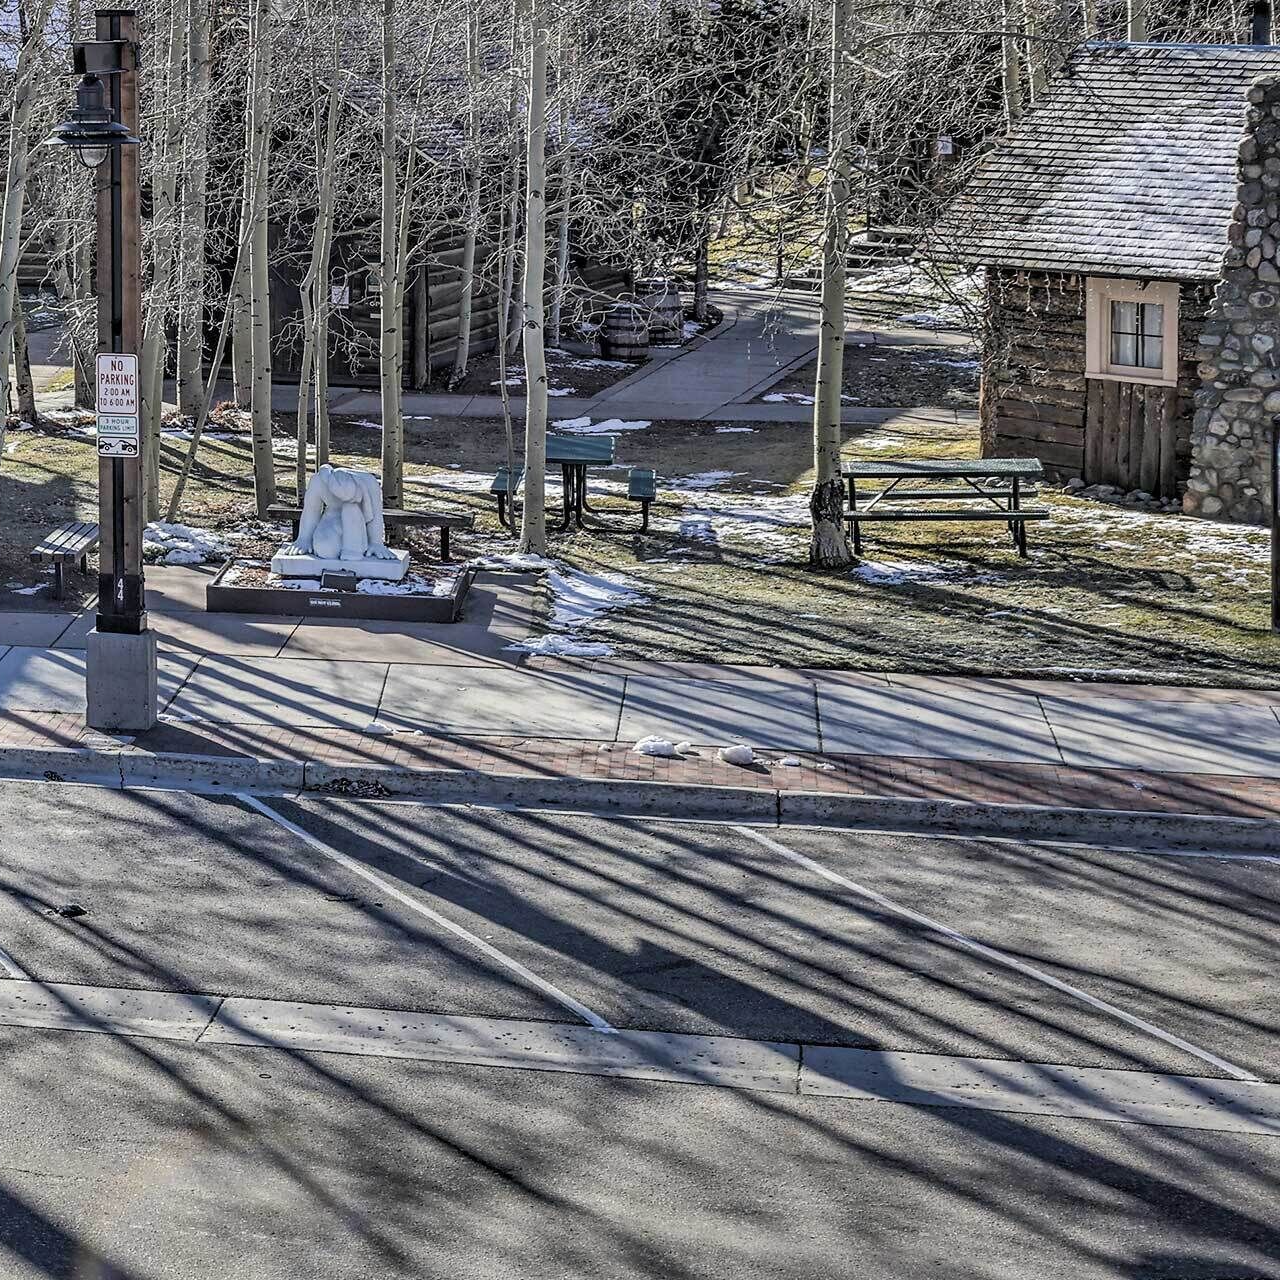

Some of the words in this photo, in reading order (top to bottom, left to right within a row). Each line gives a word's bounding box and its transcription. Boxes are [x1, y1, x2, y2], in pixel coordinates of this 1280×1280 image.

[111, 360, 124, 372] NO
[100, 373, 135, 386] PARKING
[121, 388, 131, 397] AM
[126, 399, 135, 407] AM
[100, 424, 120, 432] PARKING
[117, 578, 124, 601] 44
